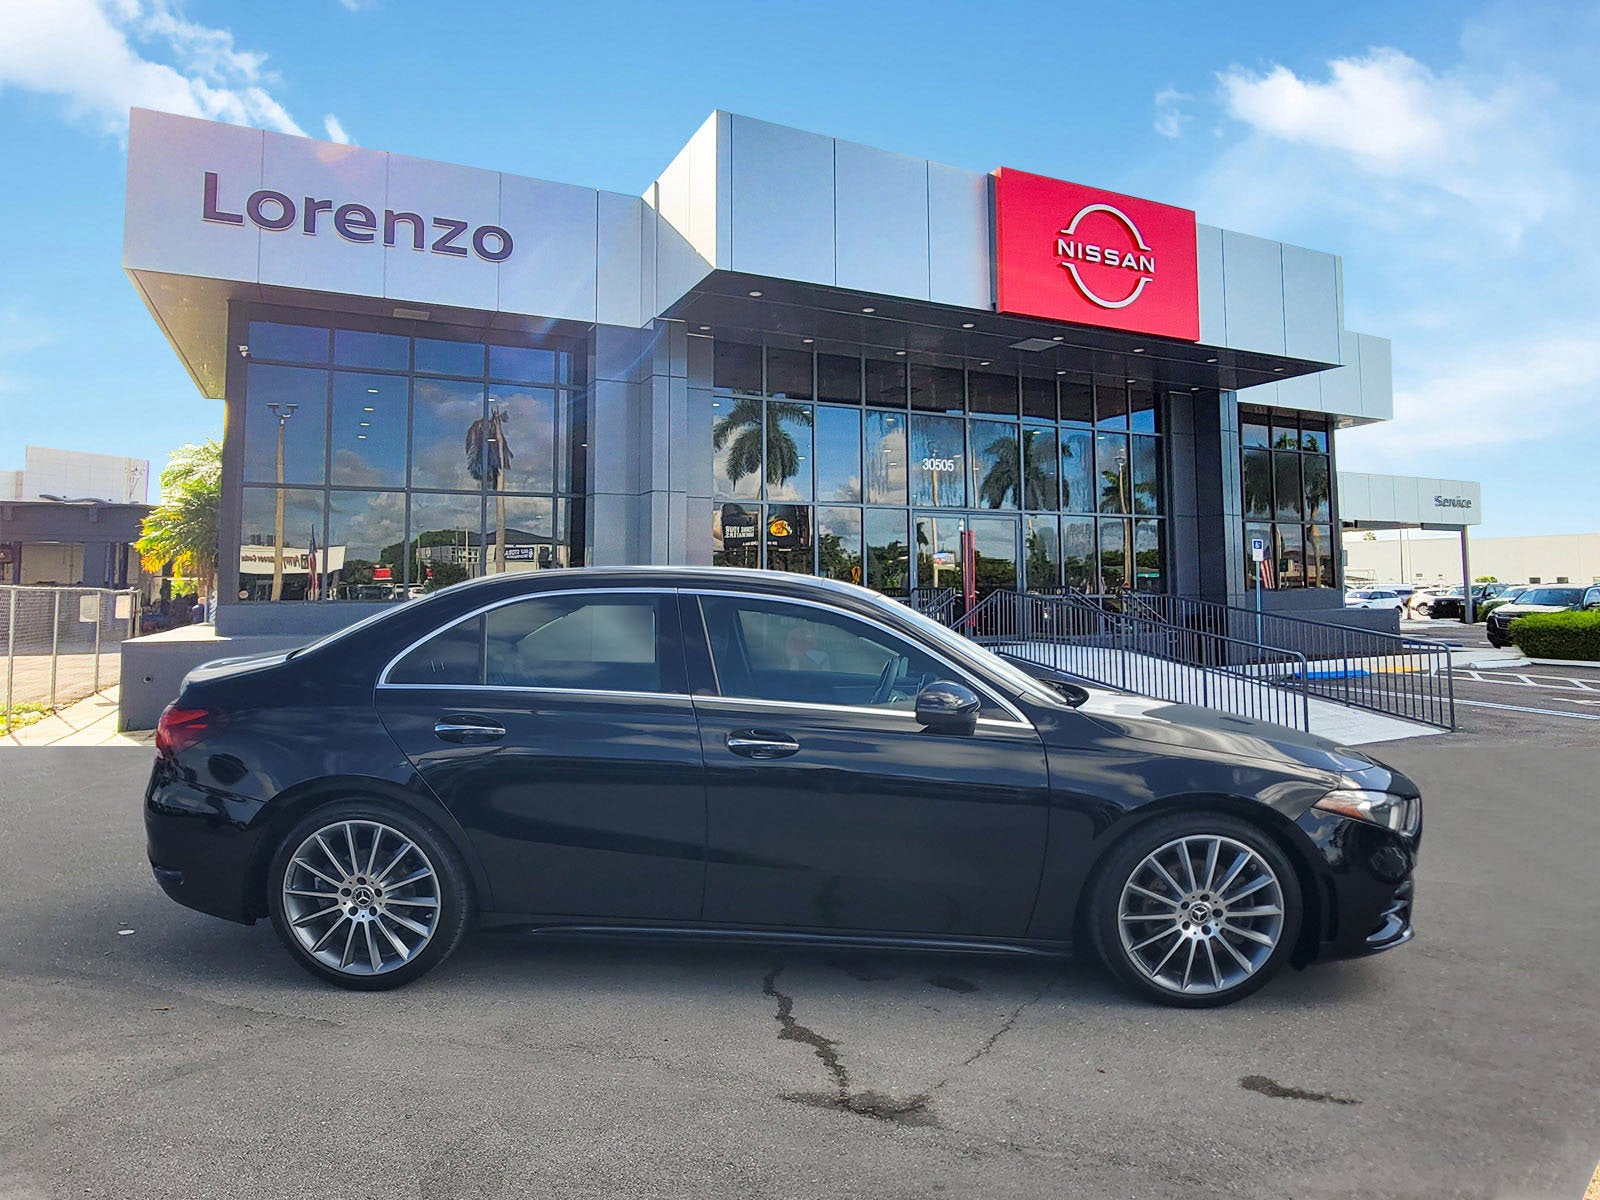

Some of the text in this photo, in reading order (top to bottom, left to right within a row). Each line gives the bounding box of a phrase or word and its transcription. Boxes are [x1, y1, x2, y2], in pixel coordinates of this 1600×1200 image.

[203, 171, 514, 262] Lorenzo
[1057, 238, 1155, 273] NISSAN
[922, 458, 955, 471] 30505
[1434, 495, 1472, 508] Service
